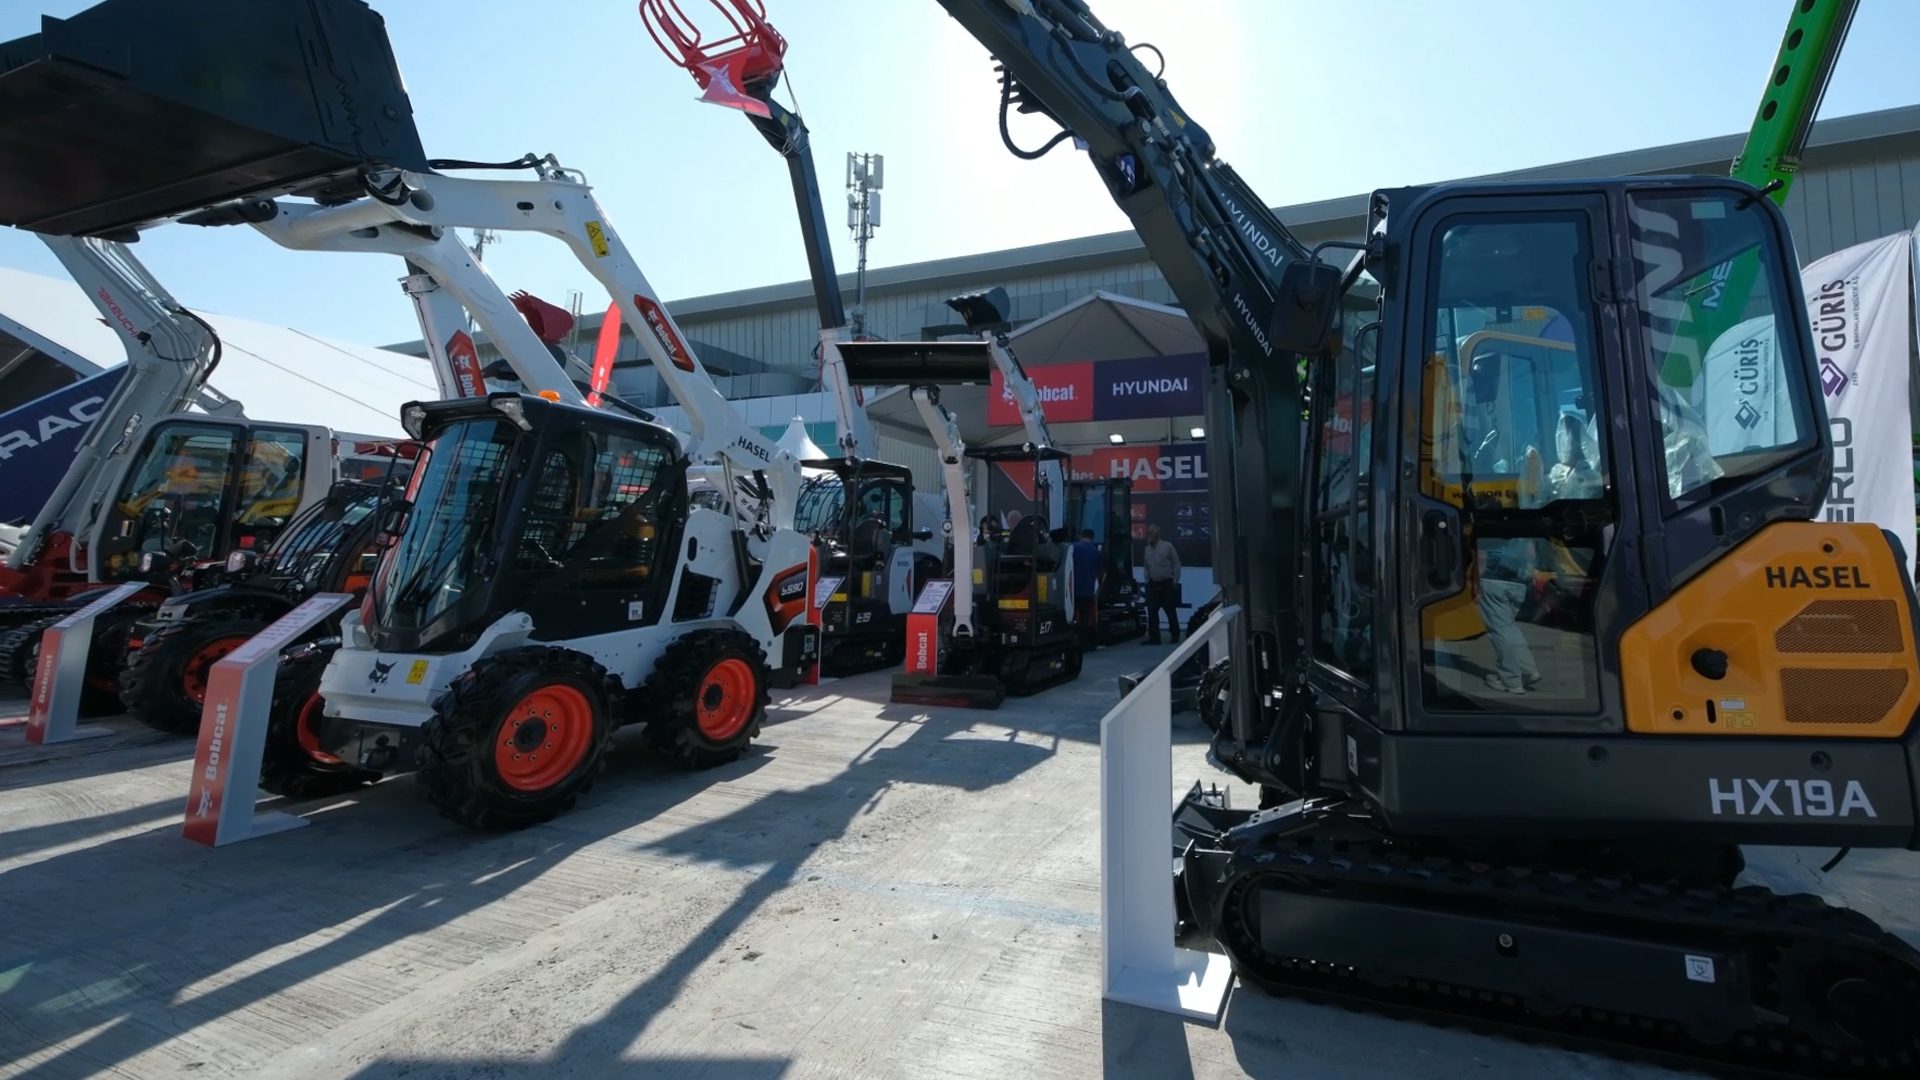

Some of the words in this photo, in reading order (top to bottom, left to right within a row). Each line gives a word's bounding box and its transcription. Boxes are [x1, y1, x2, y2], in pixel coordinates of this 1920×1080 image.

[1221, 192, 1284, 267] YUNDAI
[1233, 293, 1273, 357] HYUNDAI
[1812, 279, 1851, 352] GÜRİŞ
[655, 322, 677, 354] Bobcat
[1112, 377, 1189, 397] HYUNDAI
[1734, 339, 1763, 396] GÜRİŞ
[737, 435, 770, 463] HASEL
[1109, 455, 1209, 480] HASEL
[1764, 566, 1870, 588] HASEL
[916, 631, 928, 669] Bobcat
[38, 654, 53, 704] Bobcat
[205, 703, 228, 781] Bobcat
[1708, 778, 1878, 818] HX19A
